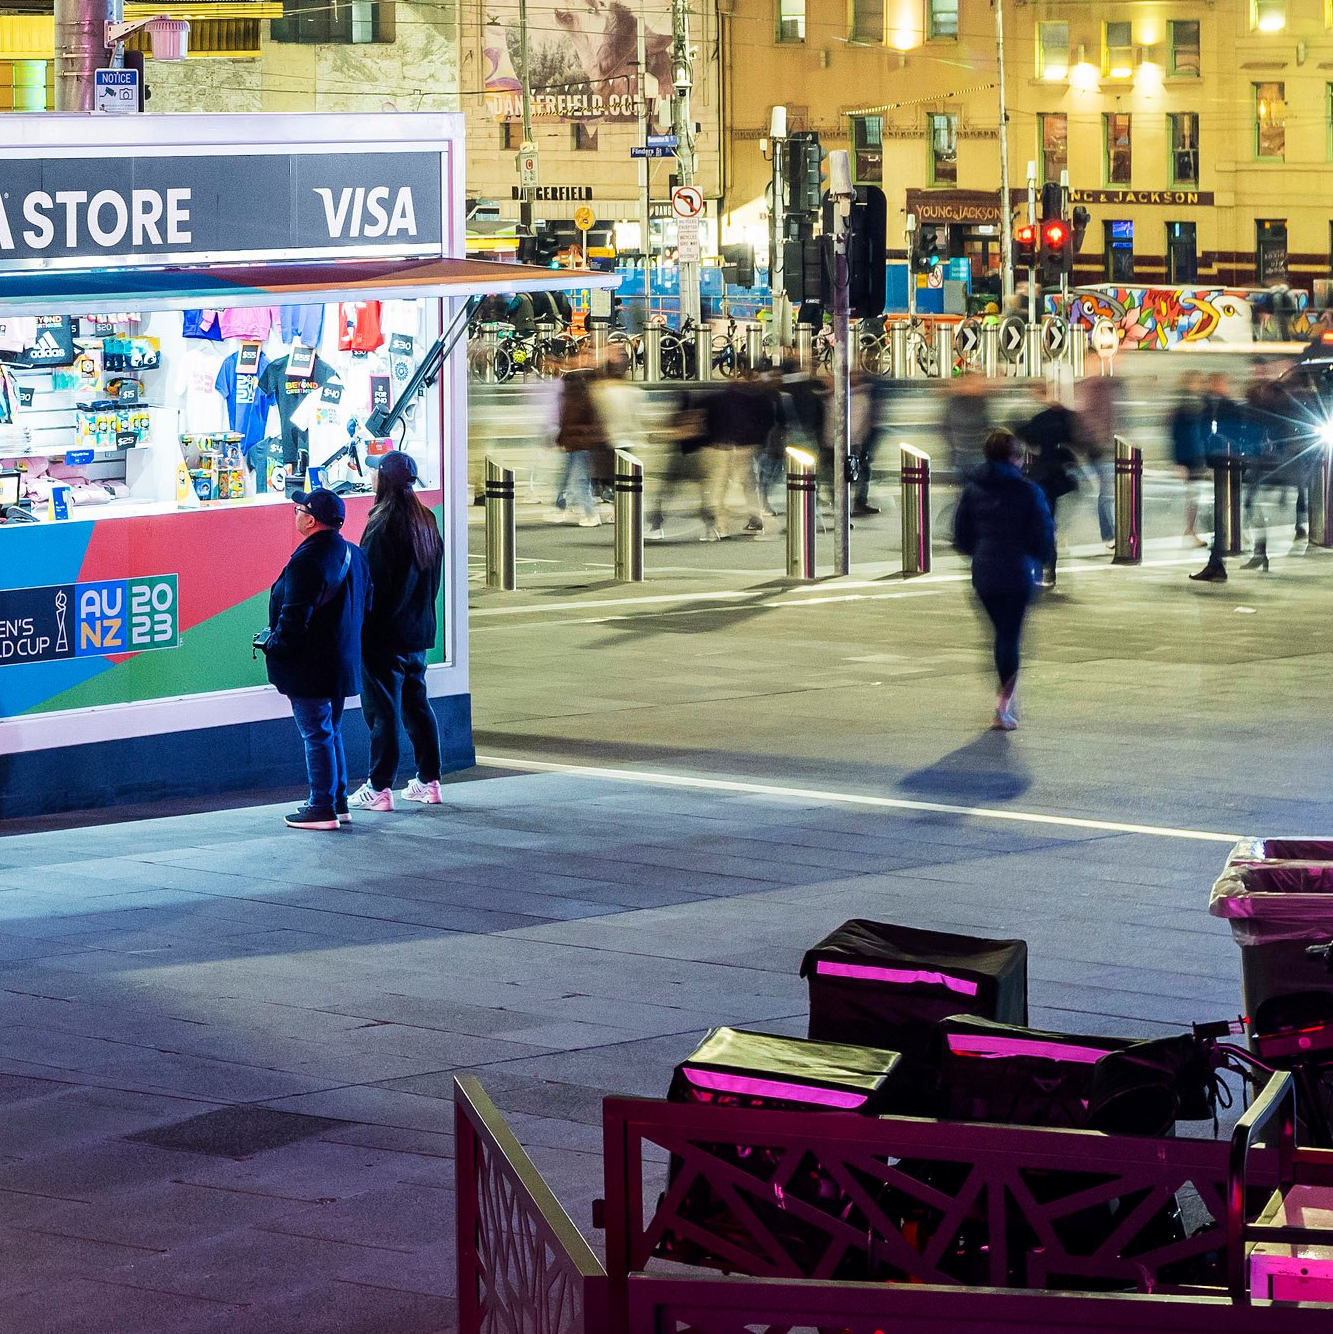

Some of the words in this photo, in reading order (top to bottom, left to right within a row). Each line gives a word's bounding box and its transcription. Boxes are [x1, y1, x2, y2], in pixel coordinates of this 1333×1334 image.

[102, 73, 131, 83] NOTICE
[632, 147, 654, 155] Flinders
[656, 147, 662, 155] St
[312, 185, 419, 239] VISA
[1114, 191, 1198, 204] JACKSON
[24, 187, 193, 249] STORE
[30, 348, 65, 358] adidas
[80, 587, 122, 619] AU
[132, 583, 173, 614] 20
[80, 619, 122, 650] NZ
[132, 613, 173, 644] 23
[16, 636, 50, 657] CUP
